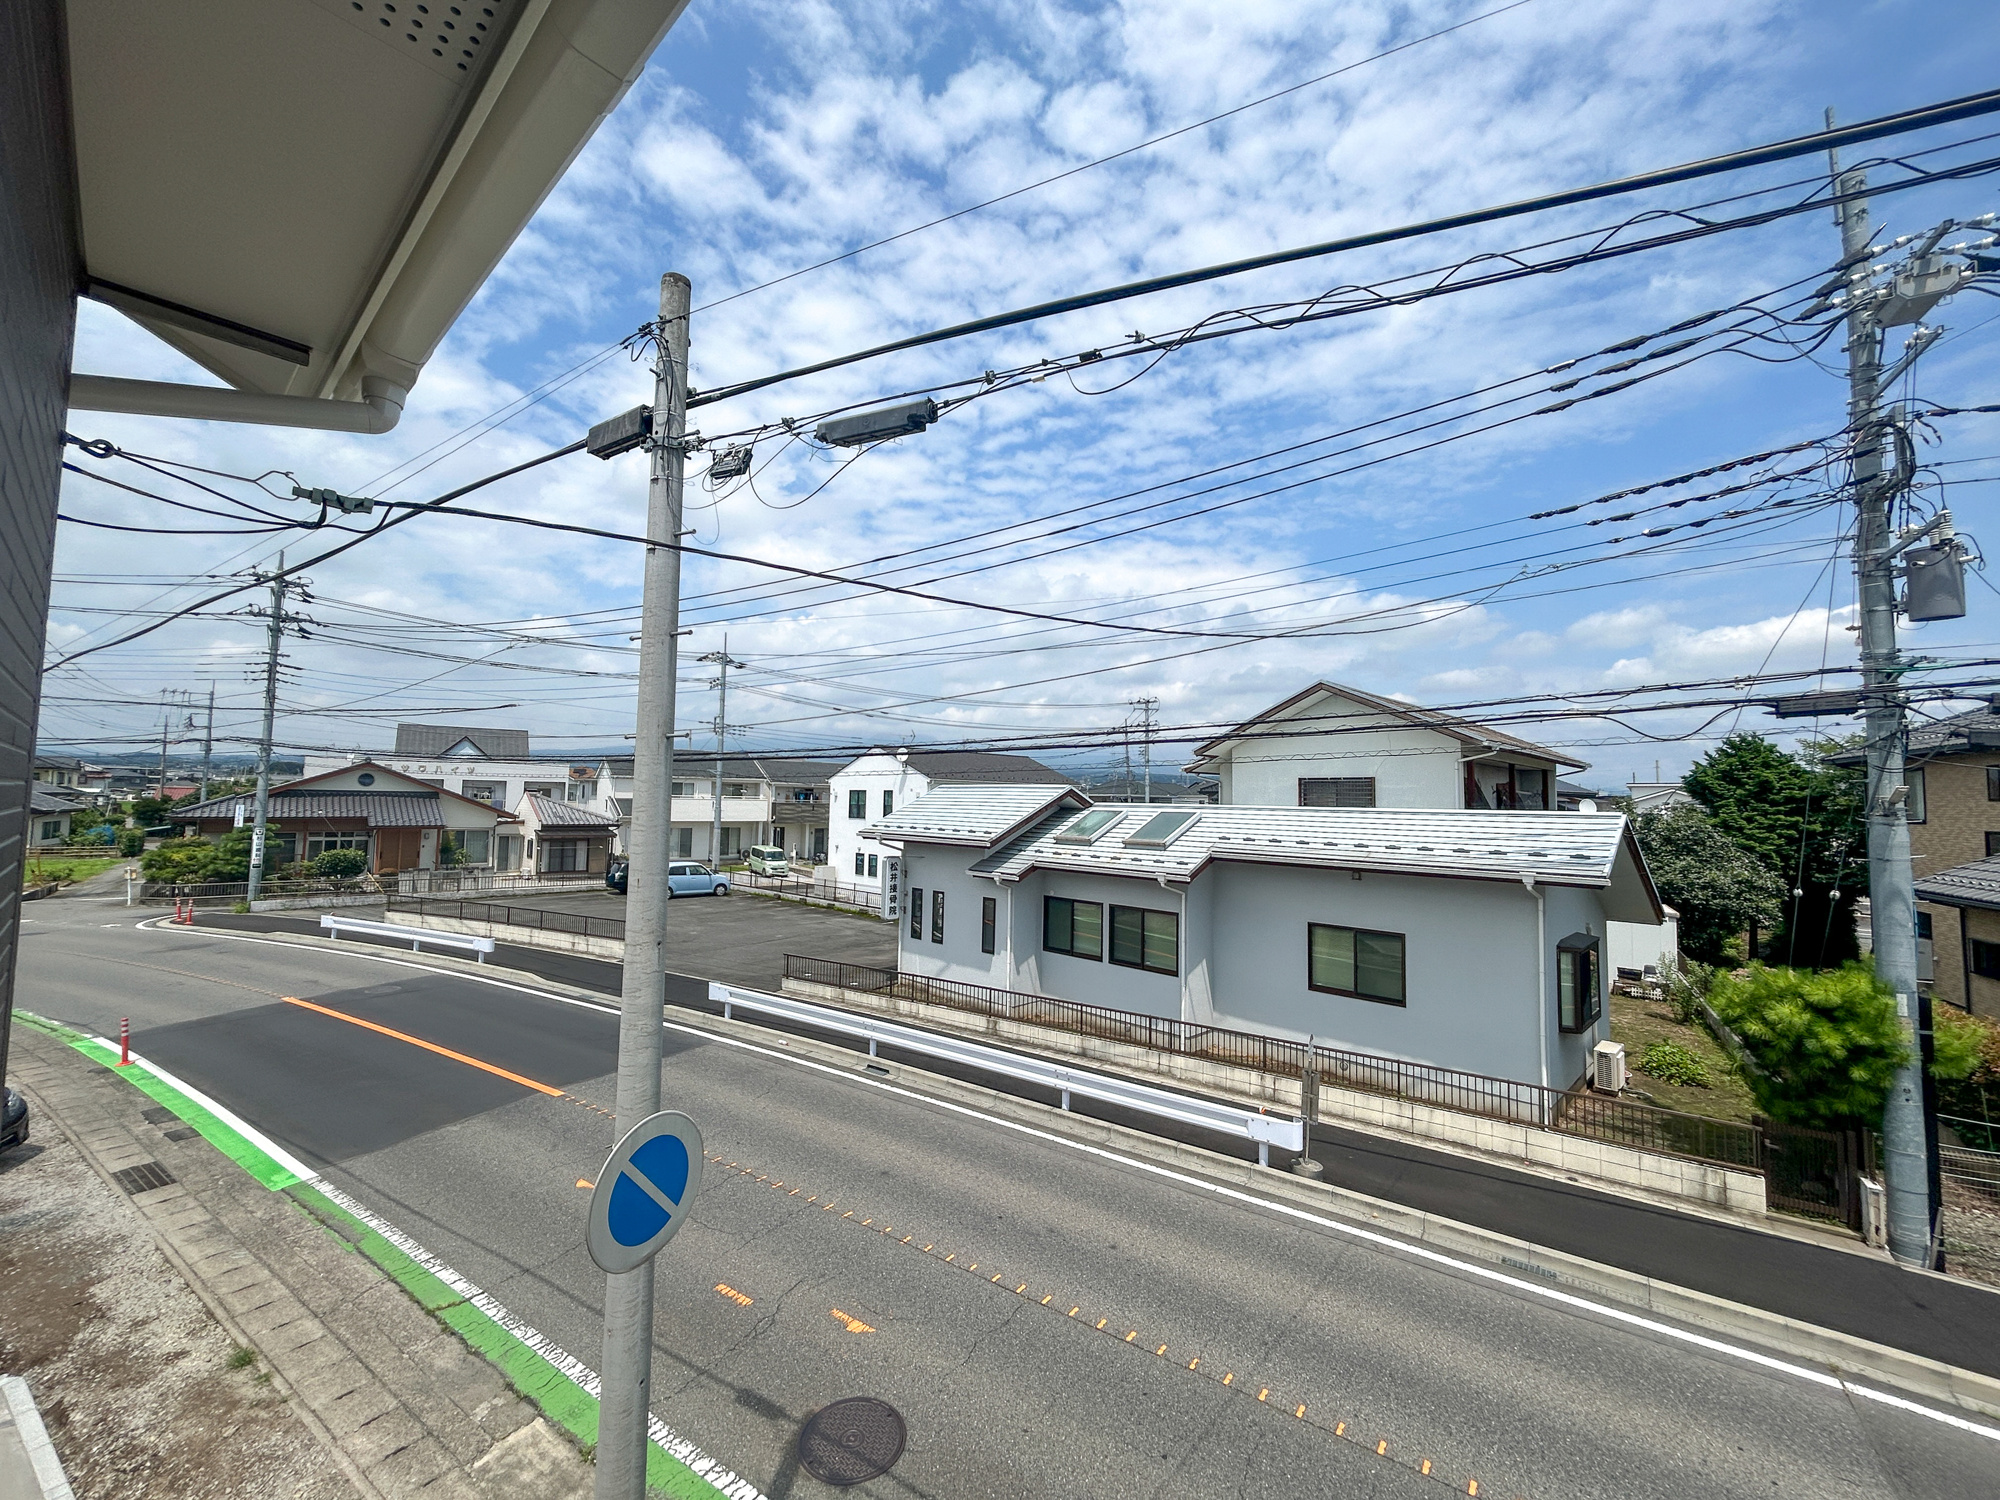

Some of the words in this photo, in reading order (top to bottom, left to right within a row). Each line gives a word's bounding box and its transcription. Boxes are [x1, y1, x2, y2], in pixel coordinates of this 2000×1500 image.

[889, 861, 899, 915] 松井接骨院
